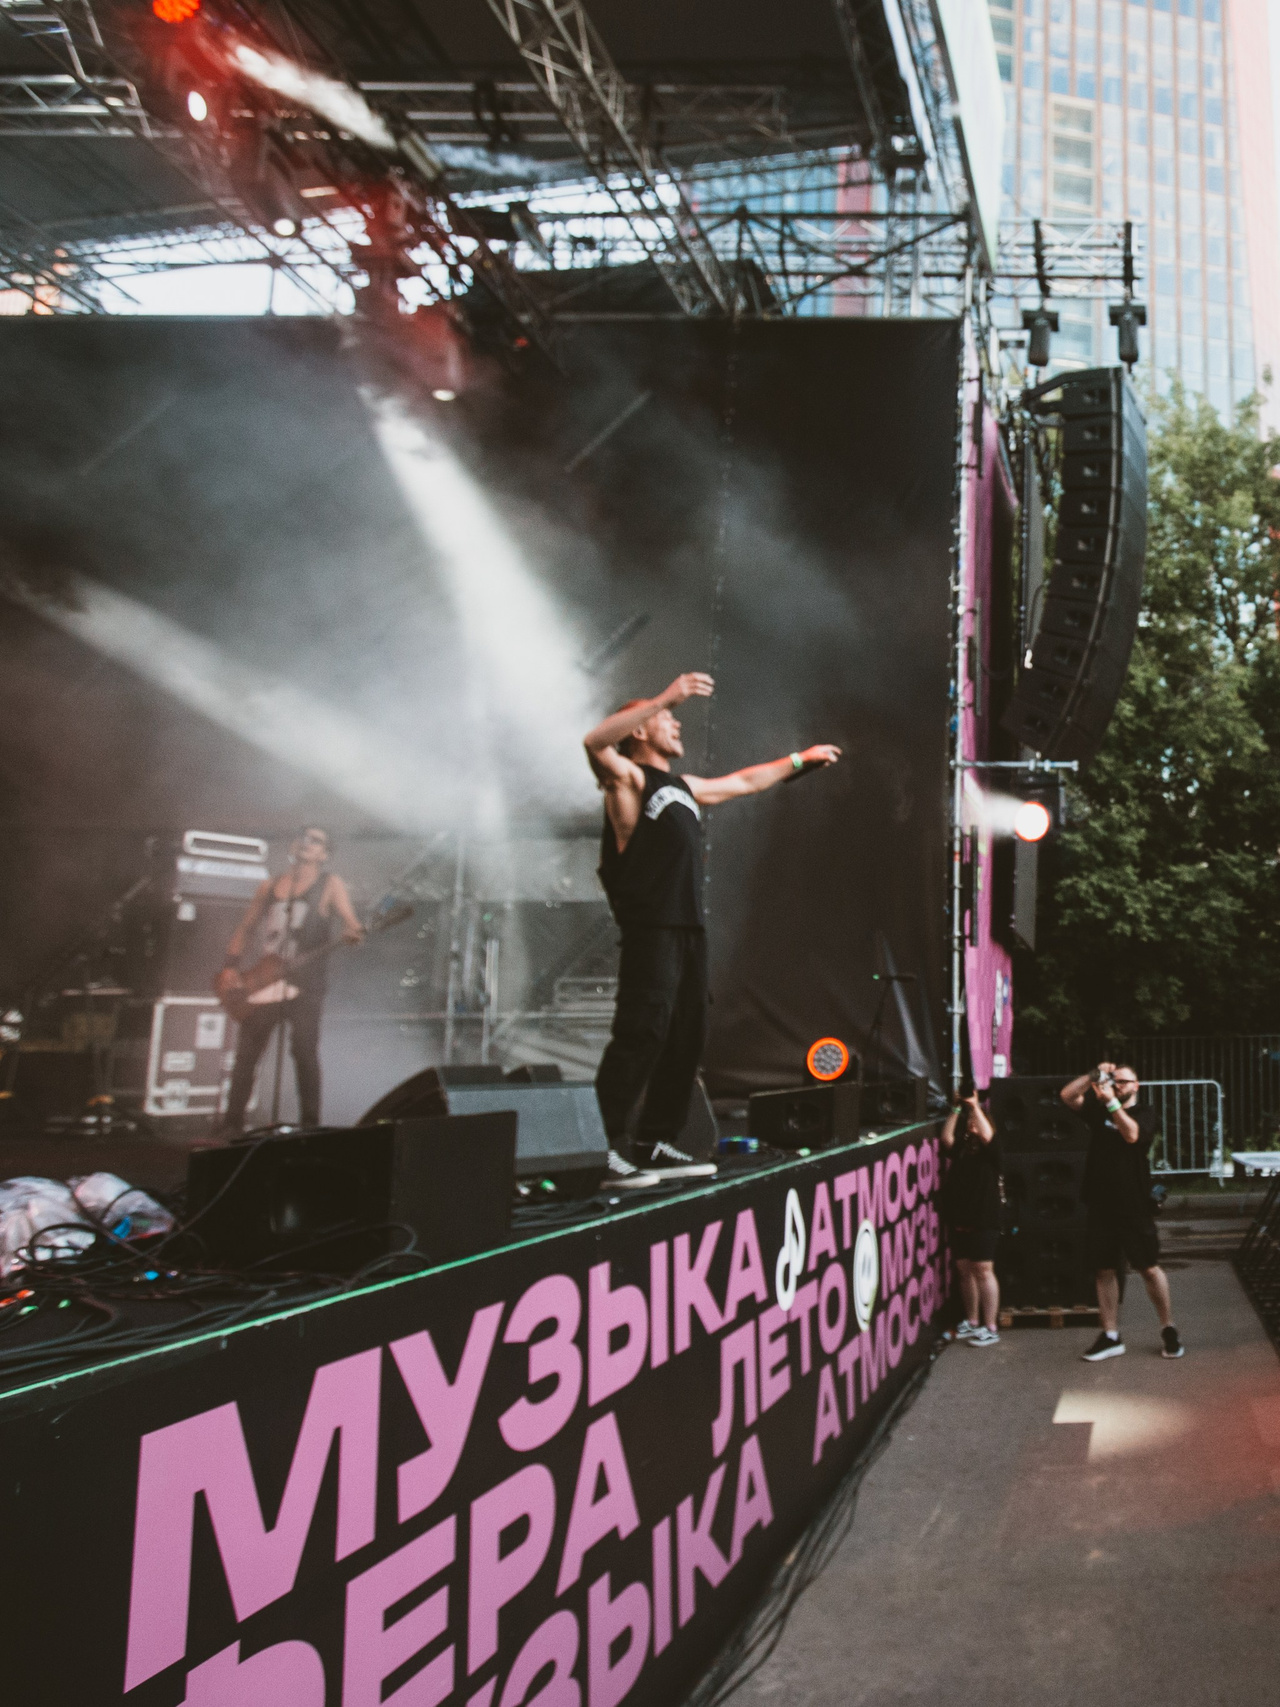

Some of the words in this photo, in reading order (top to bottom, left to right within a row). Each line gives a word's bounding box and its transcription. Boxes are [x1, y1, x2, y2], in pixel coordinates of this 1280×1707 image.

[122, 1207, 769, 1695] МУЗЫКА
[175, 1410, 641, 1707] ЕРА
[711, 1261, 849, 1459] ЛЕТО
[465, 1433, 775, 1707] ЗЫКА
